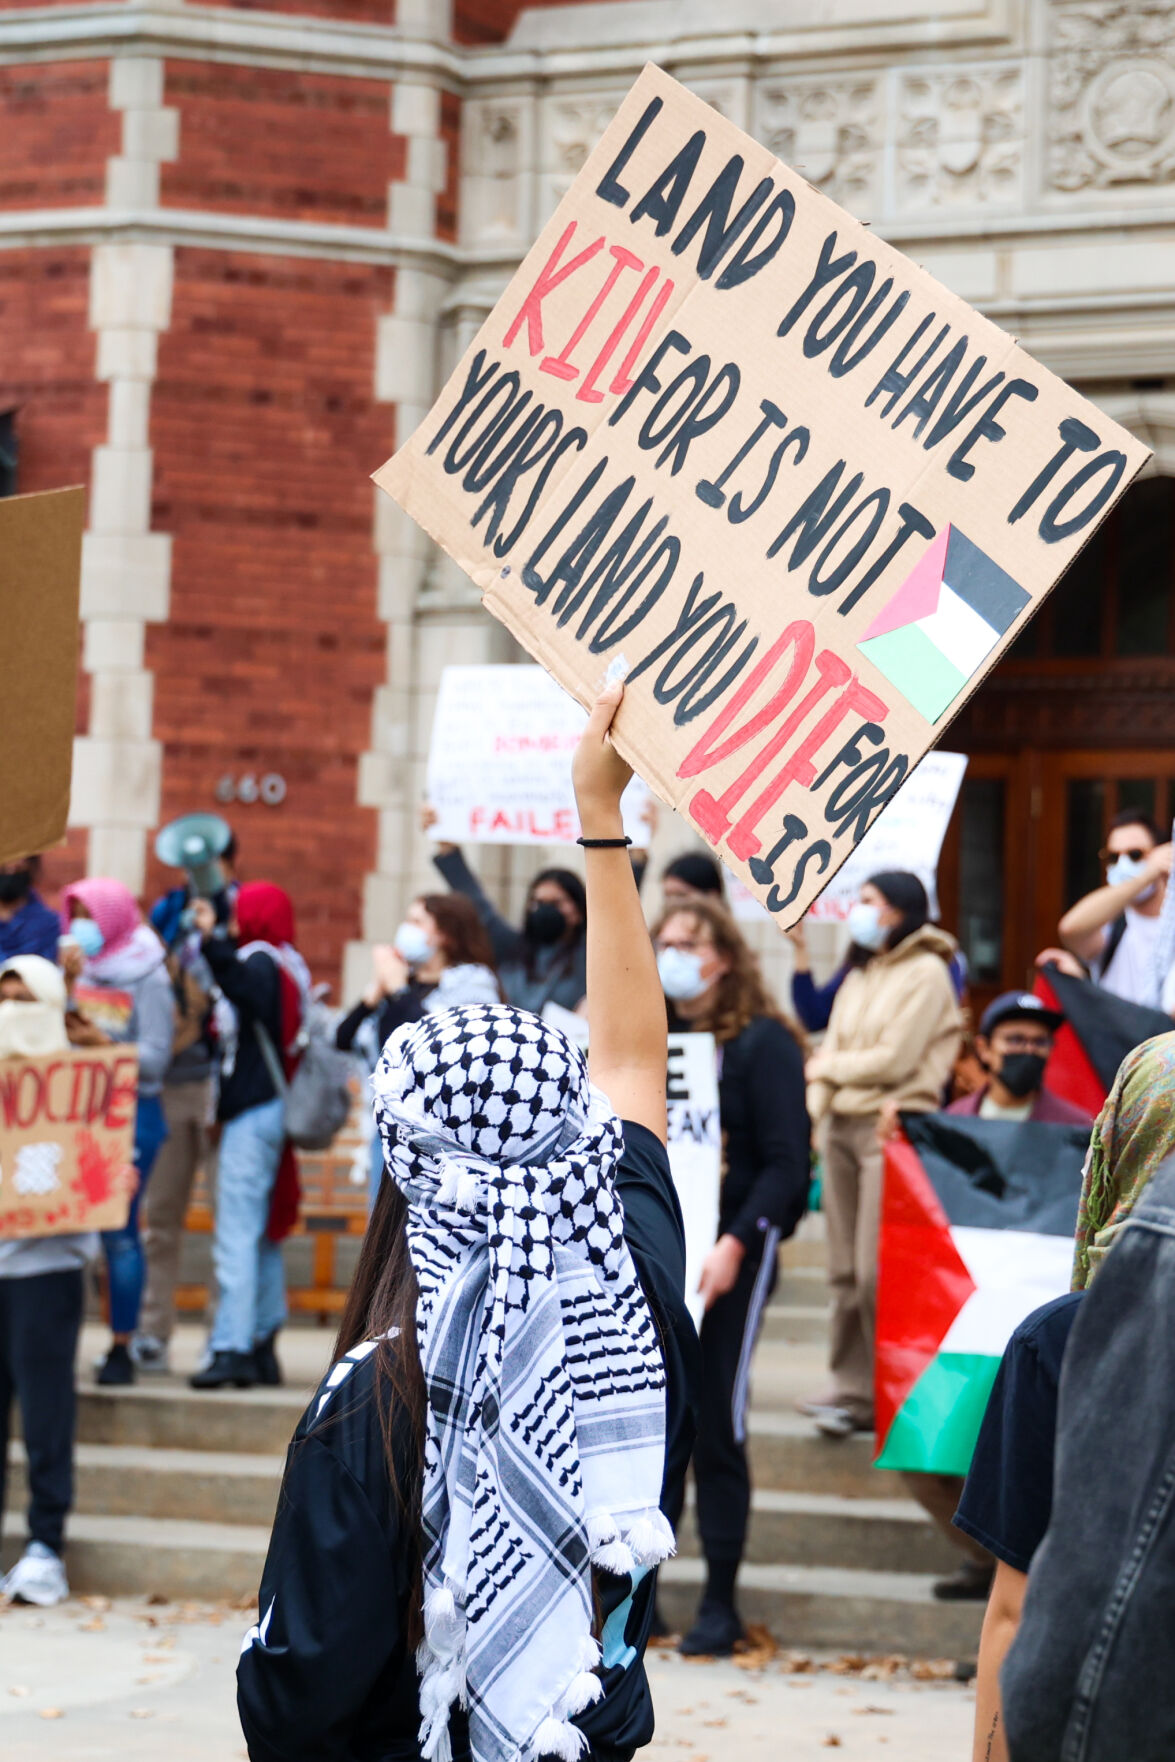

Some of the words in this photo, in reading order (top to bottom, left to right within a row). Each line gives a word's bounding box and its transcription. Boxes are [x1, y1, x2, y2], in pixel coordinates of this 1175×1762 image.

[501, 220, 675, 404] KILL
[608, 329, 742, 477] FOR
[695, 398, 811, 525] IS
[765, 459, 937, 618] NOT
[595, 95, 796, 290] LAND
[776, 231, 911, 379] YOU
[864, 311, 1039, 483] HAVE
[1006, 416, 1128, 545] TO
[425, 348, 589, 559] YOURS
[521, 455, 682, 654] LAND
[624, 571, 760, 727] YOU
[469, 806, 581, 842] FAILE
[675, 619, 891, 863] DIE
[809, 721, 909, 843] FOR
[748, 813, 832, 913] IS
